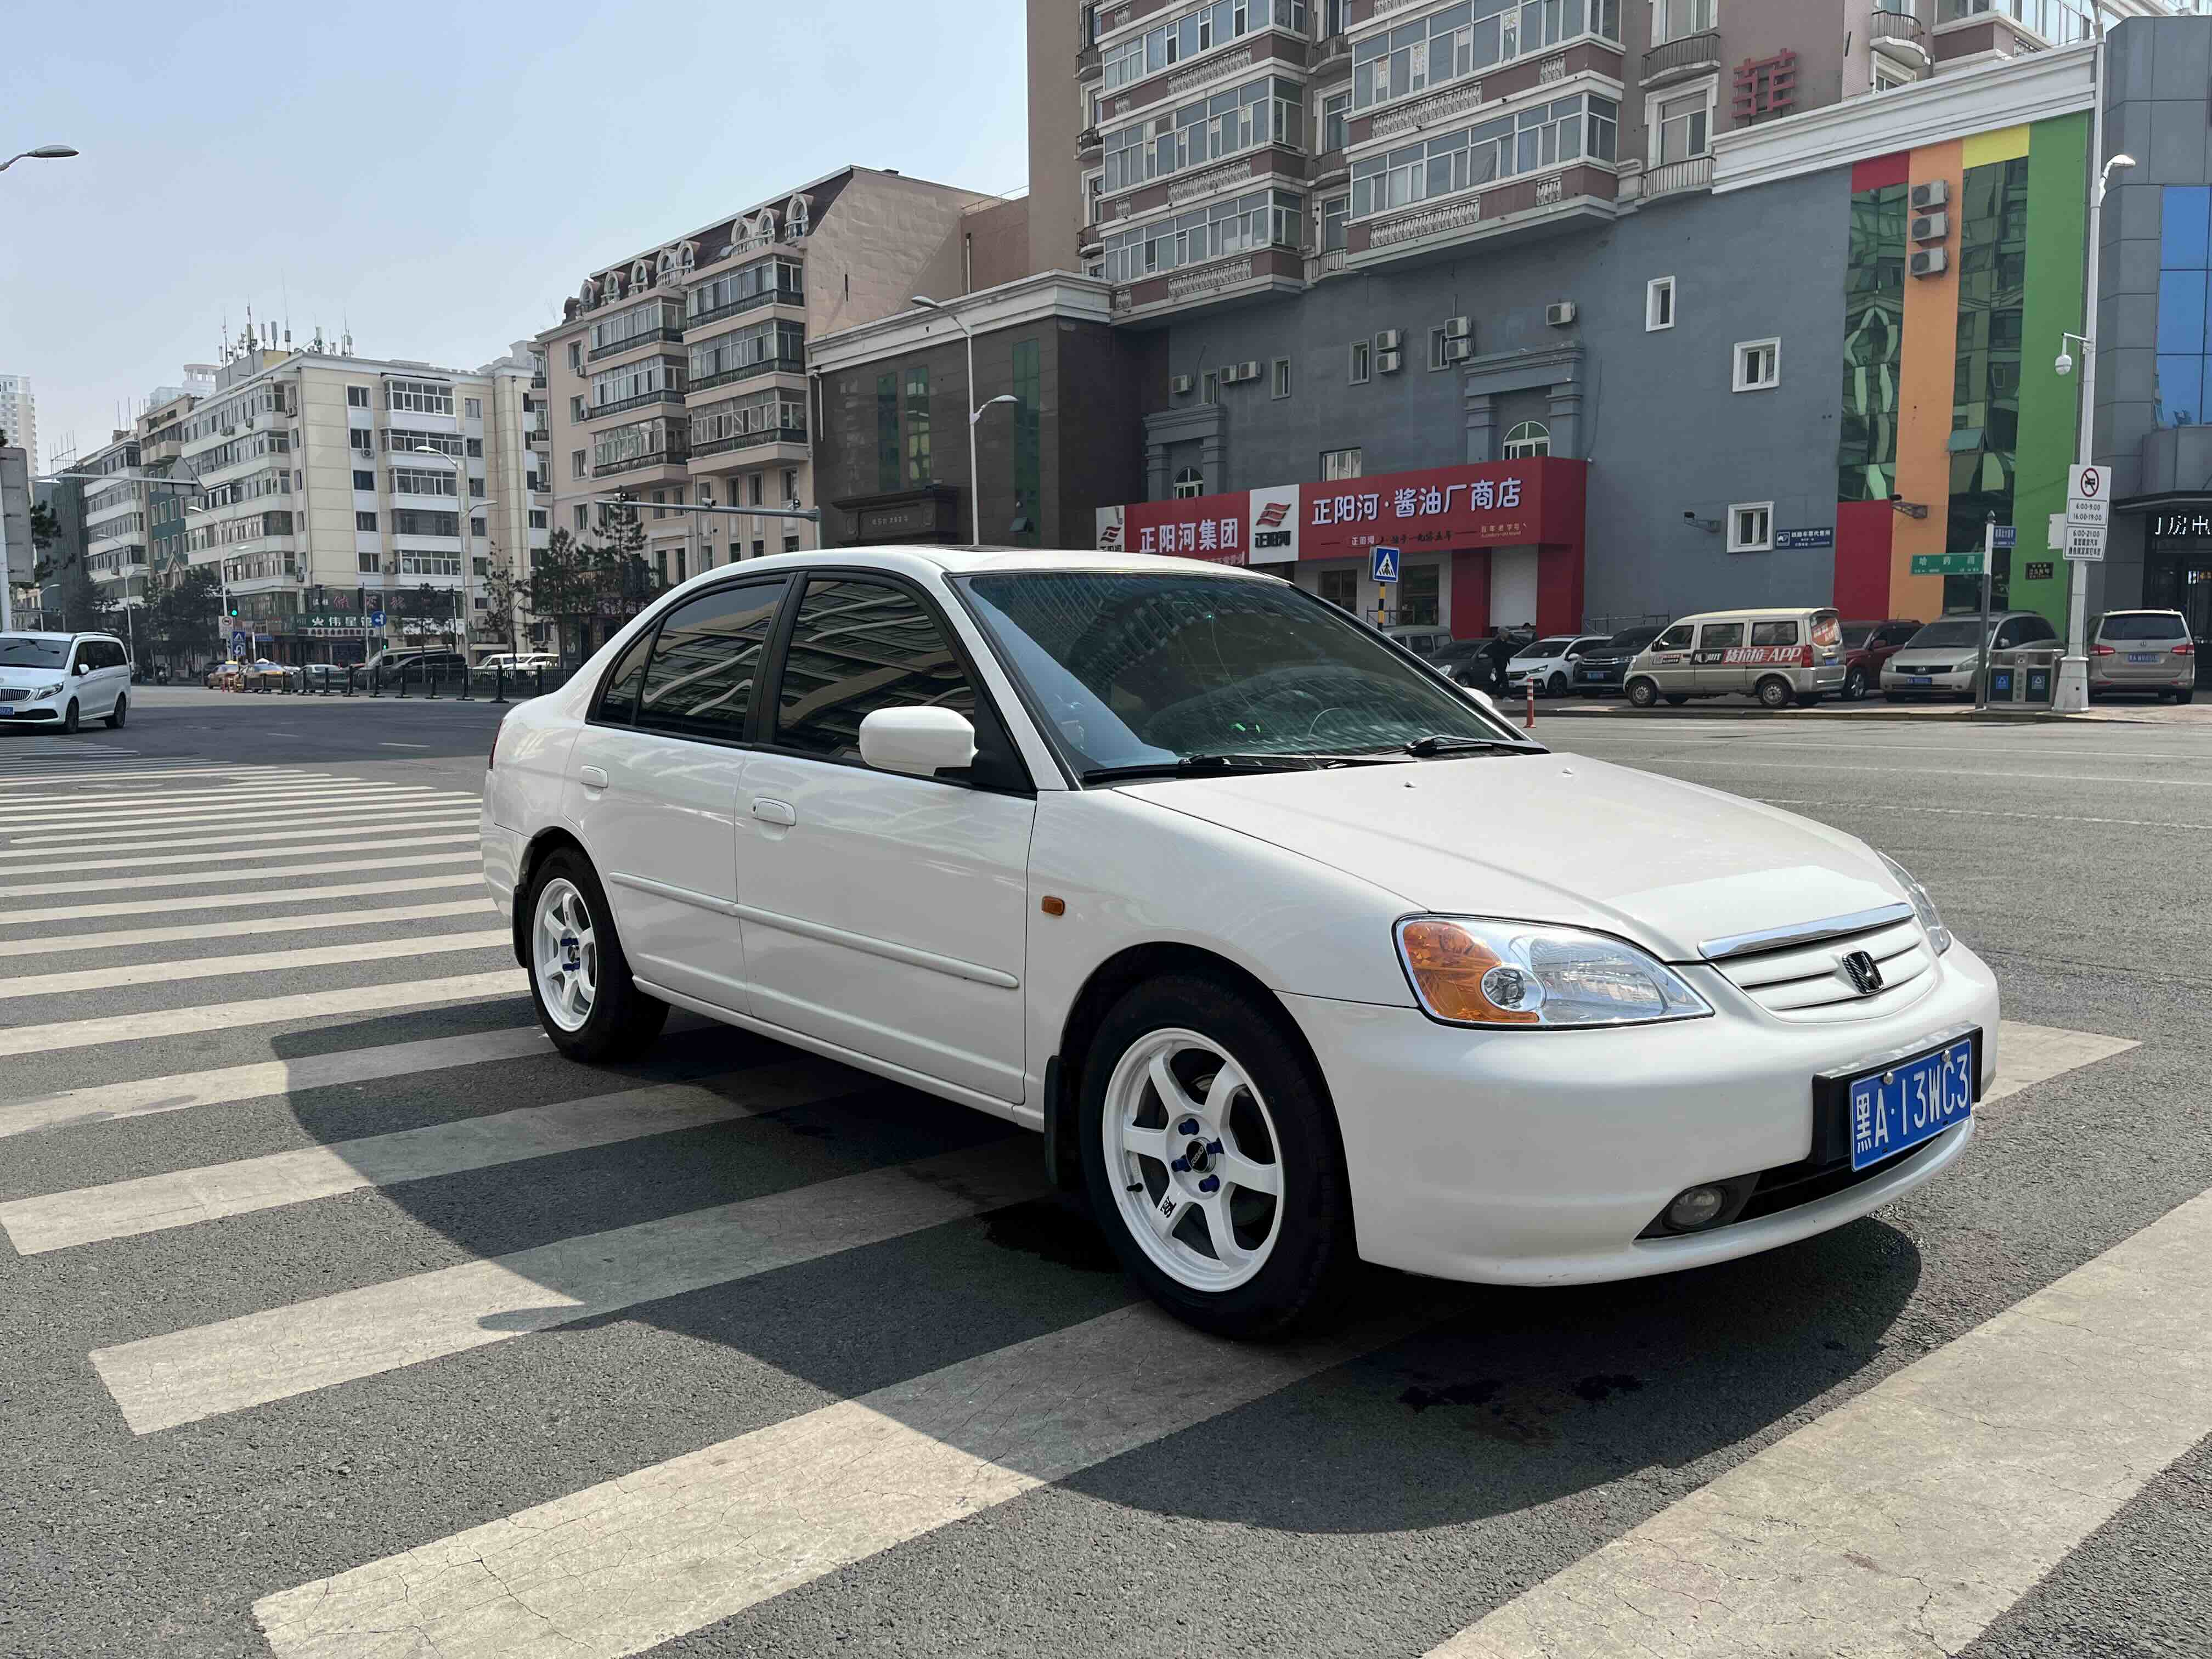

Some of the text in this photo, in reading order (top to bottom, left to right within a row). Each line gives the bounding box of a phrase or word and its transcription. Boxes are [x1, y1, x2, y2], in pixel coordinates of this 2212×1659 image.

[1312, 477, 1522, 526] 正阳河·酱油厂商店
[1139, 518, 1238, 554] 正阳河集团
[1255, 531, 1291, 548] 正阳河
[1767, 647, 1802, 662] APP
[1856, 1053, 1969, 1154] 黑A·13WC3
